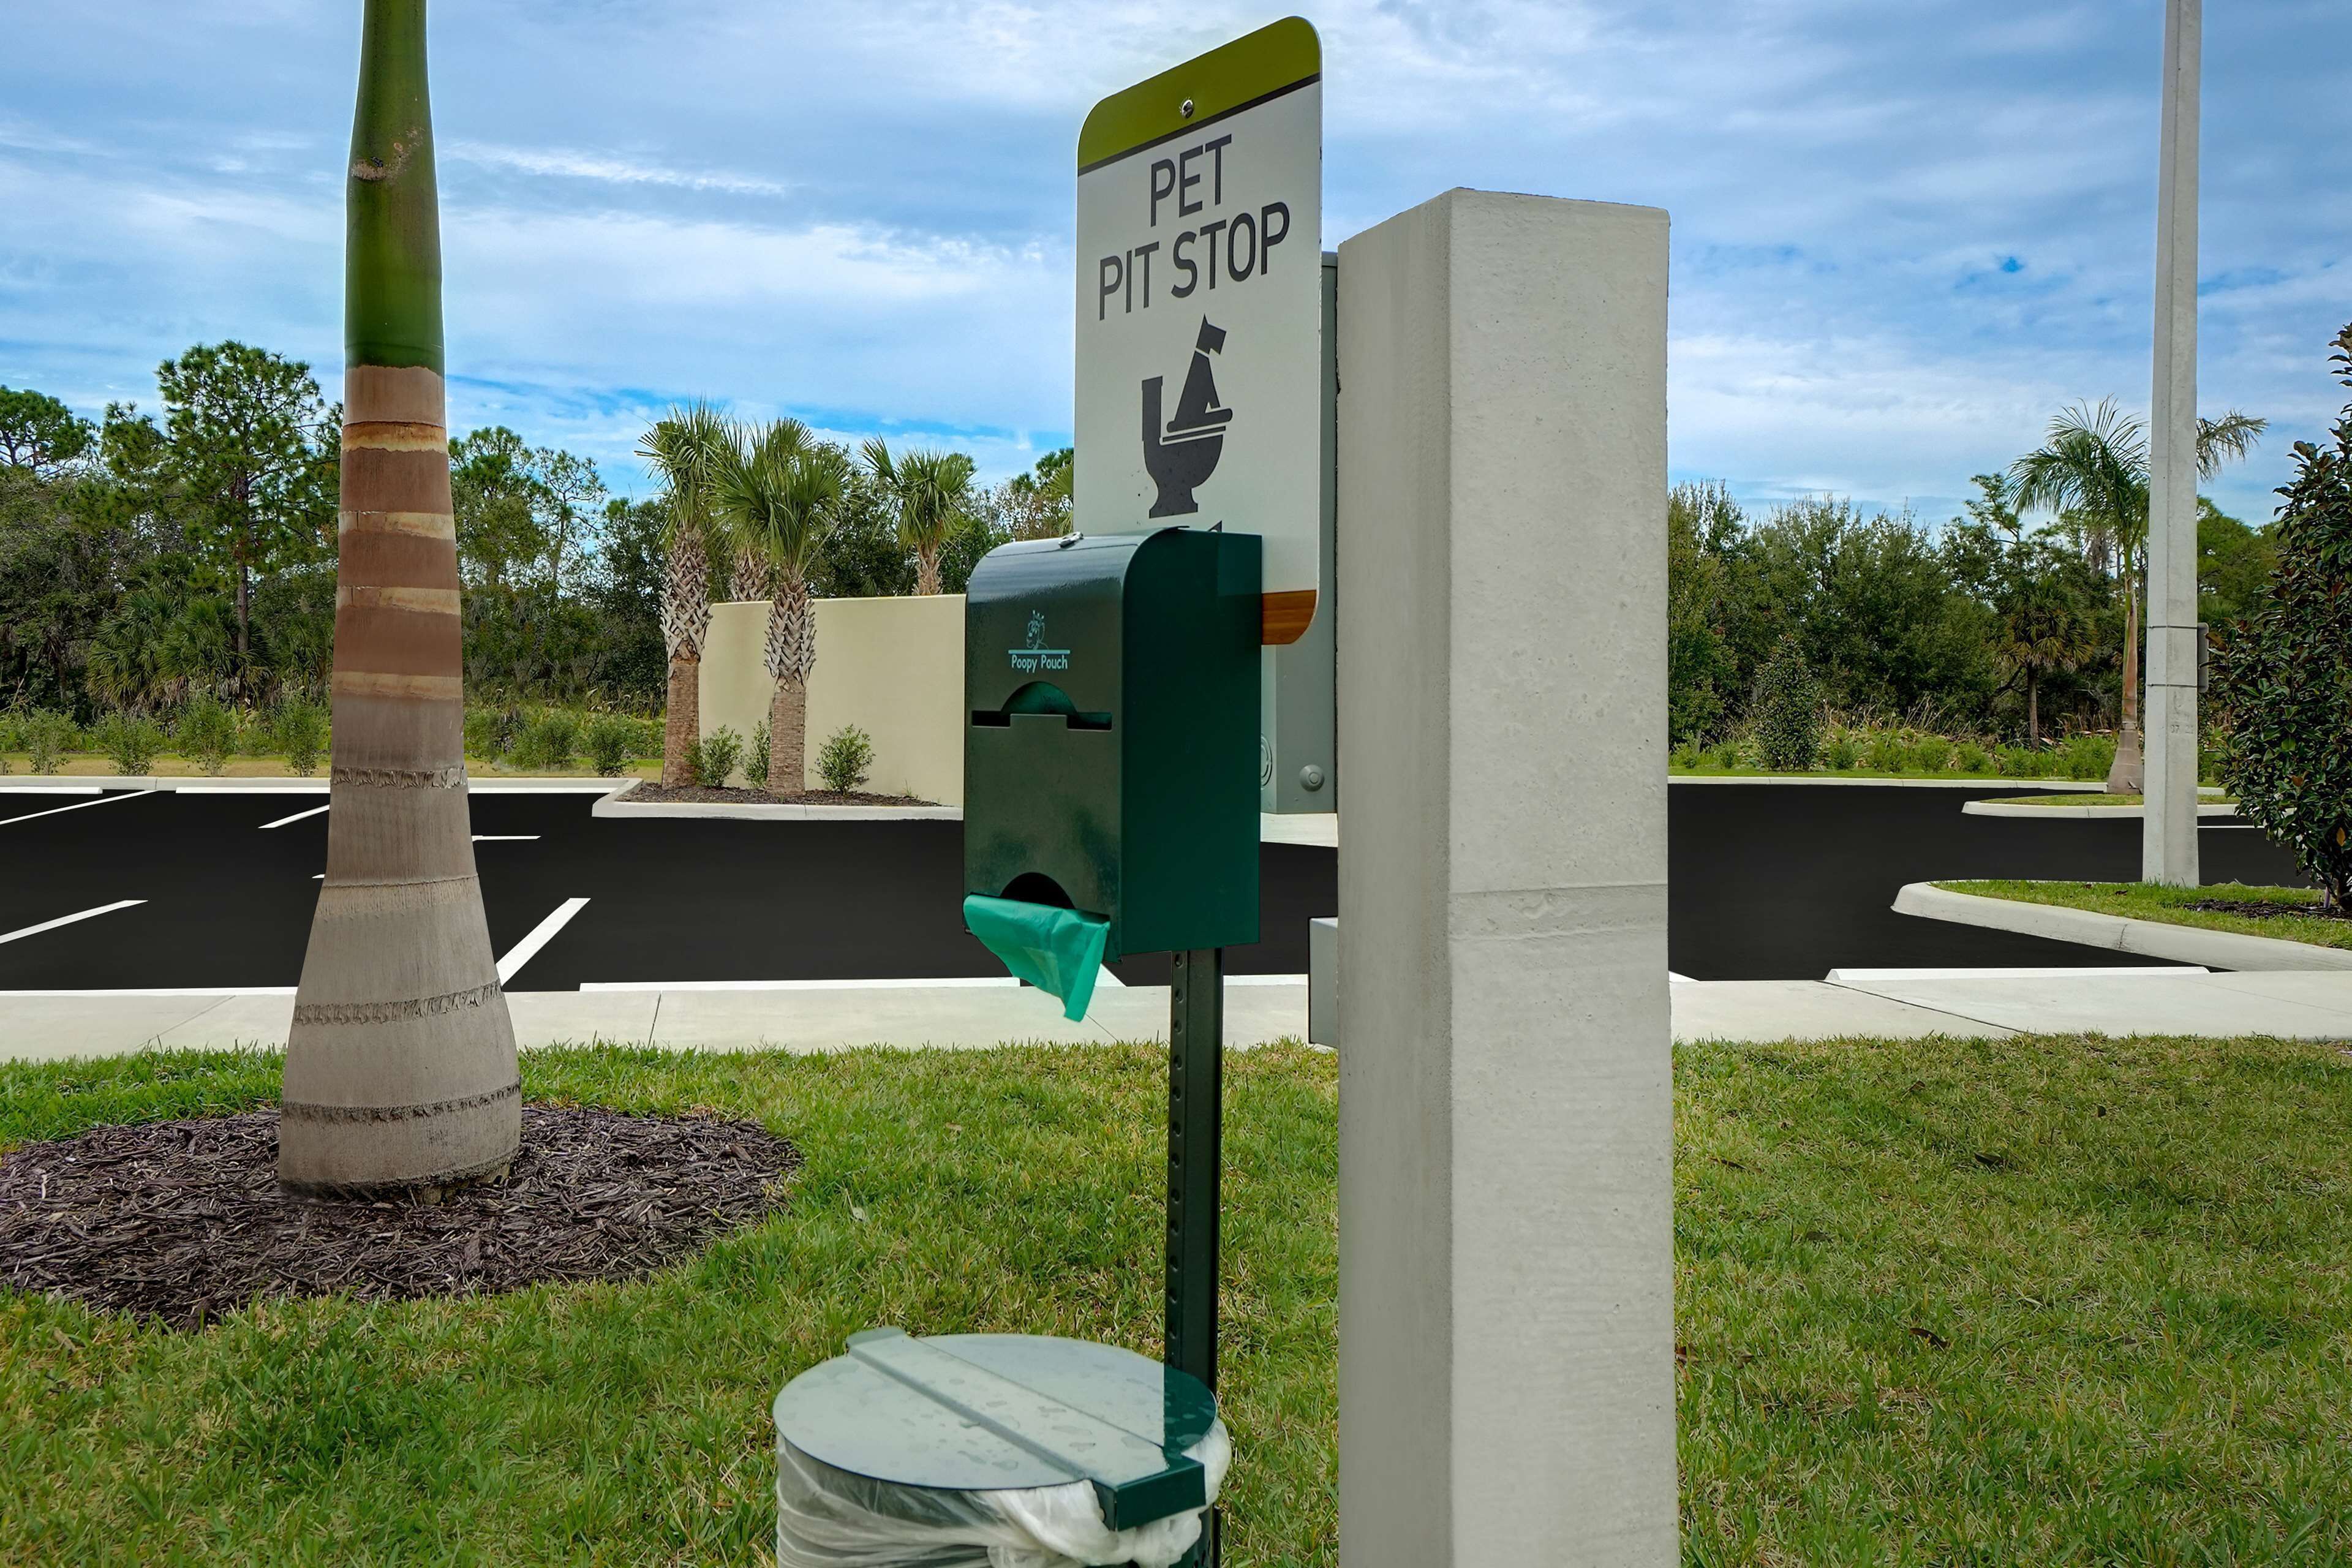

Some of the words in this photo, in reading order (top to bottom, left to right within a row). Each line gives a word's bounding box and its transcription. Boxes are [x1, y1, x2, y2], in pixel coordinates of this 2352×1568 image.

[1150, 134, 1232, 227] PET
[1099, 241, 1159, 321] PIT
[1170, 202, 1290, 298] STOP
[1011, 654, 1038, 673] Poopy
[1041, 654, 1068, 669] Pouch
